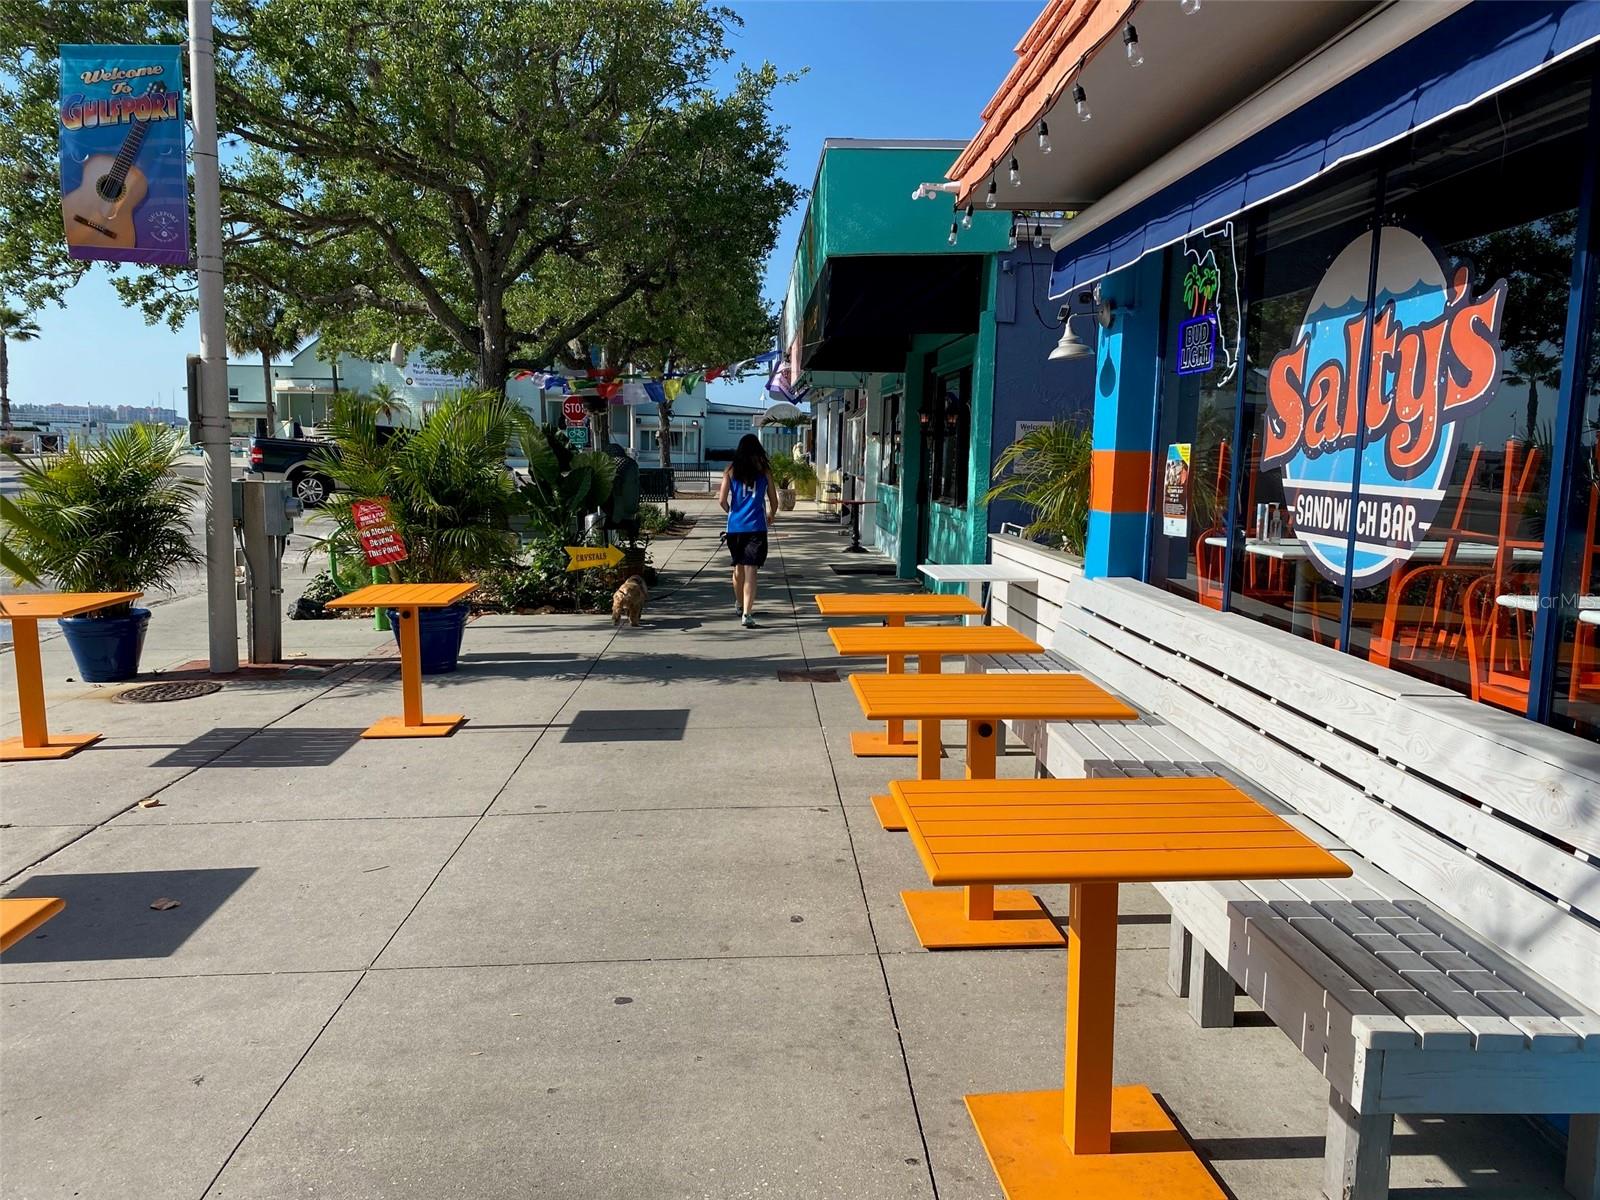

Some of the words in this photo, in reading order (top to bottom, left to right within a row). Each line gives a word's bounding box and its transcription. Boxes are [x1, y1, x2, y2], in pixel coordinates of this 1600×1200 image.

[80, 65, 164, 84] Welcome
[111, 82, 133, 95] To
[61, 91, 180, 131] GULFPORT
[1185, 322, 1209, 347] BUD
[1180, 342, 1213, 369] LIGHT
[1263, 266, 1503, 469] Salty's
[1295, 494, 1378, 537] SANDWICH
[1379, 502, 1417, 543] BAR
[368, 548, 382, 557] This
[575, 552, 607, 561] CRYSTALS
